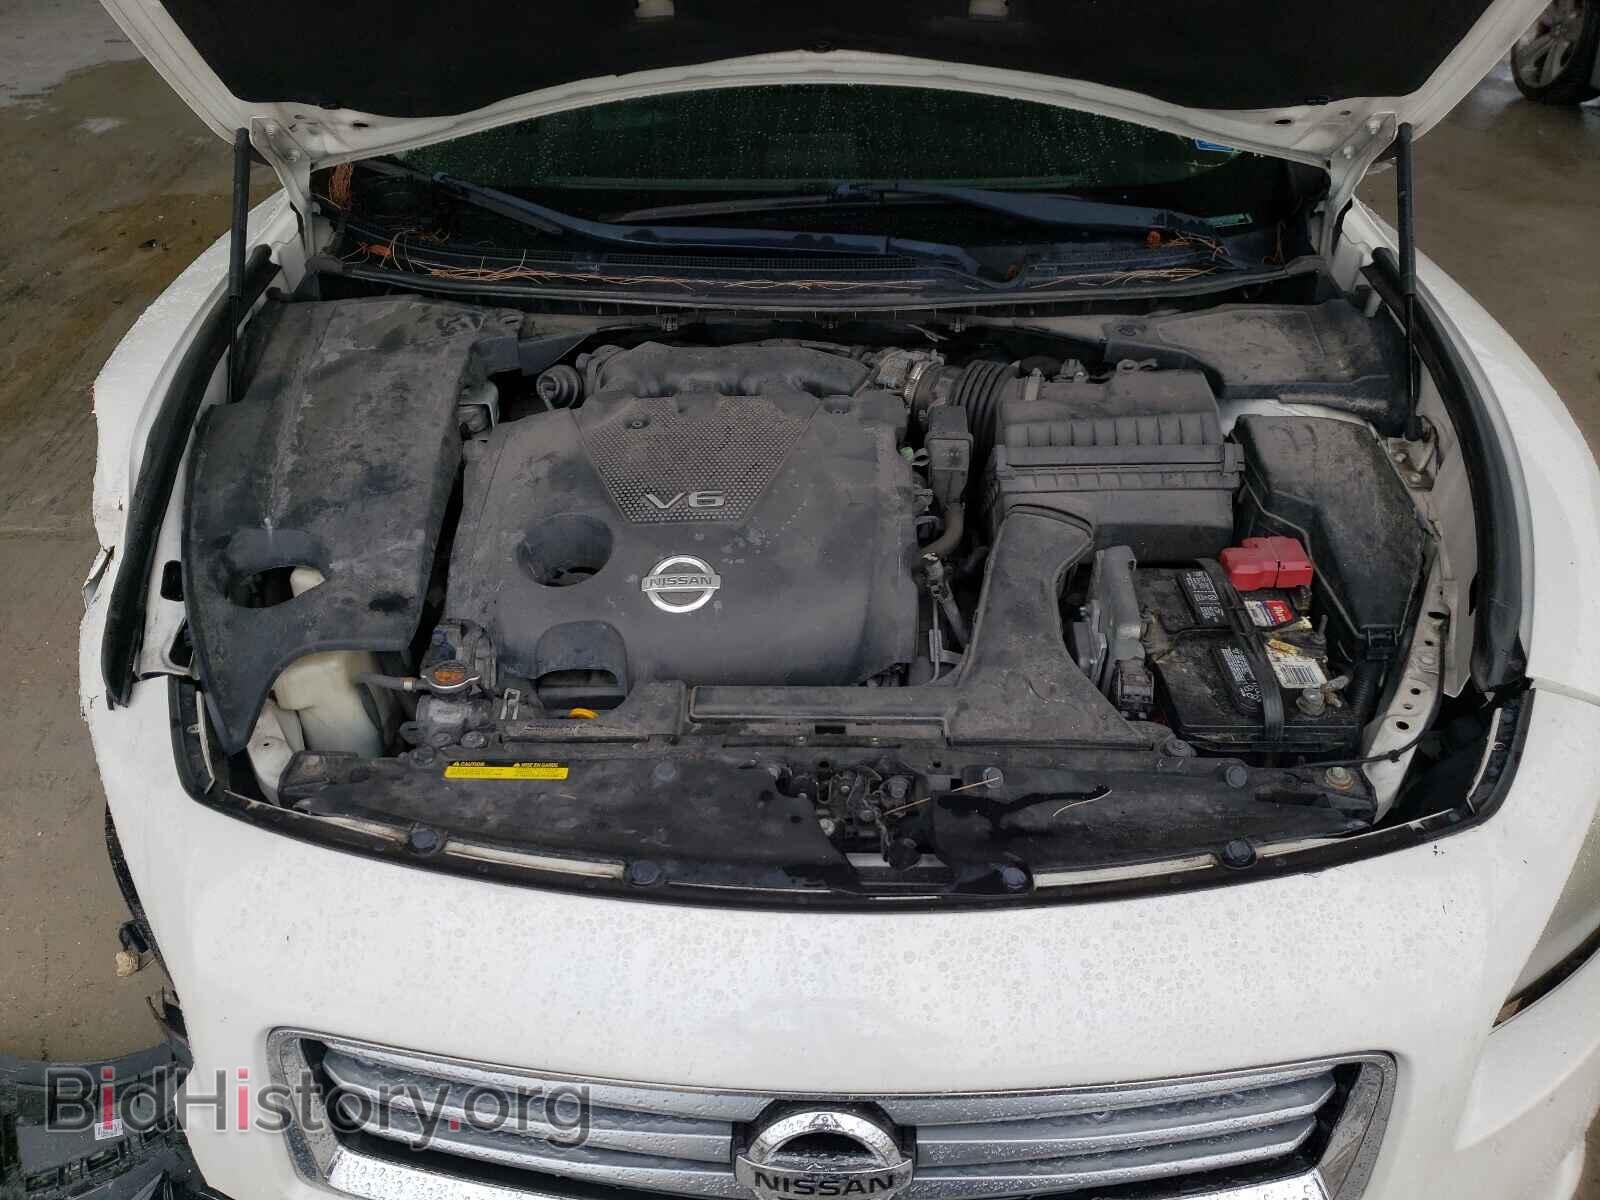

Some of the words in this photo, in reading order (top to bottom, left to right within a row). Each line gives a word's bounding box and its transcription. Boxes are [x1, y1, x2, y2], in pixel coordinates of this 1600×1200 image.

[645, 490, 725, 508] V6
[649, 576, 713, 587] NISSAN
[755, 1172, 895, 1195] NISSAN
